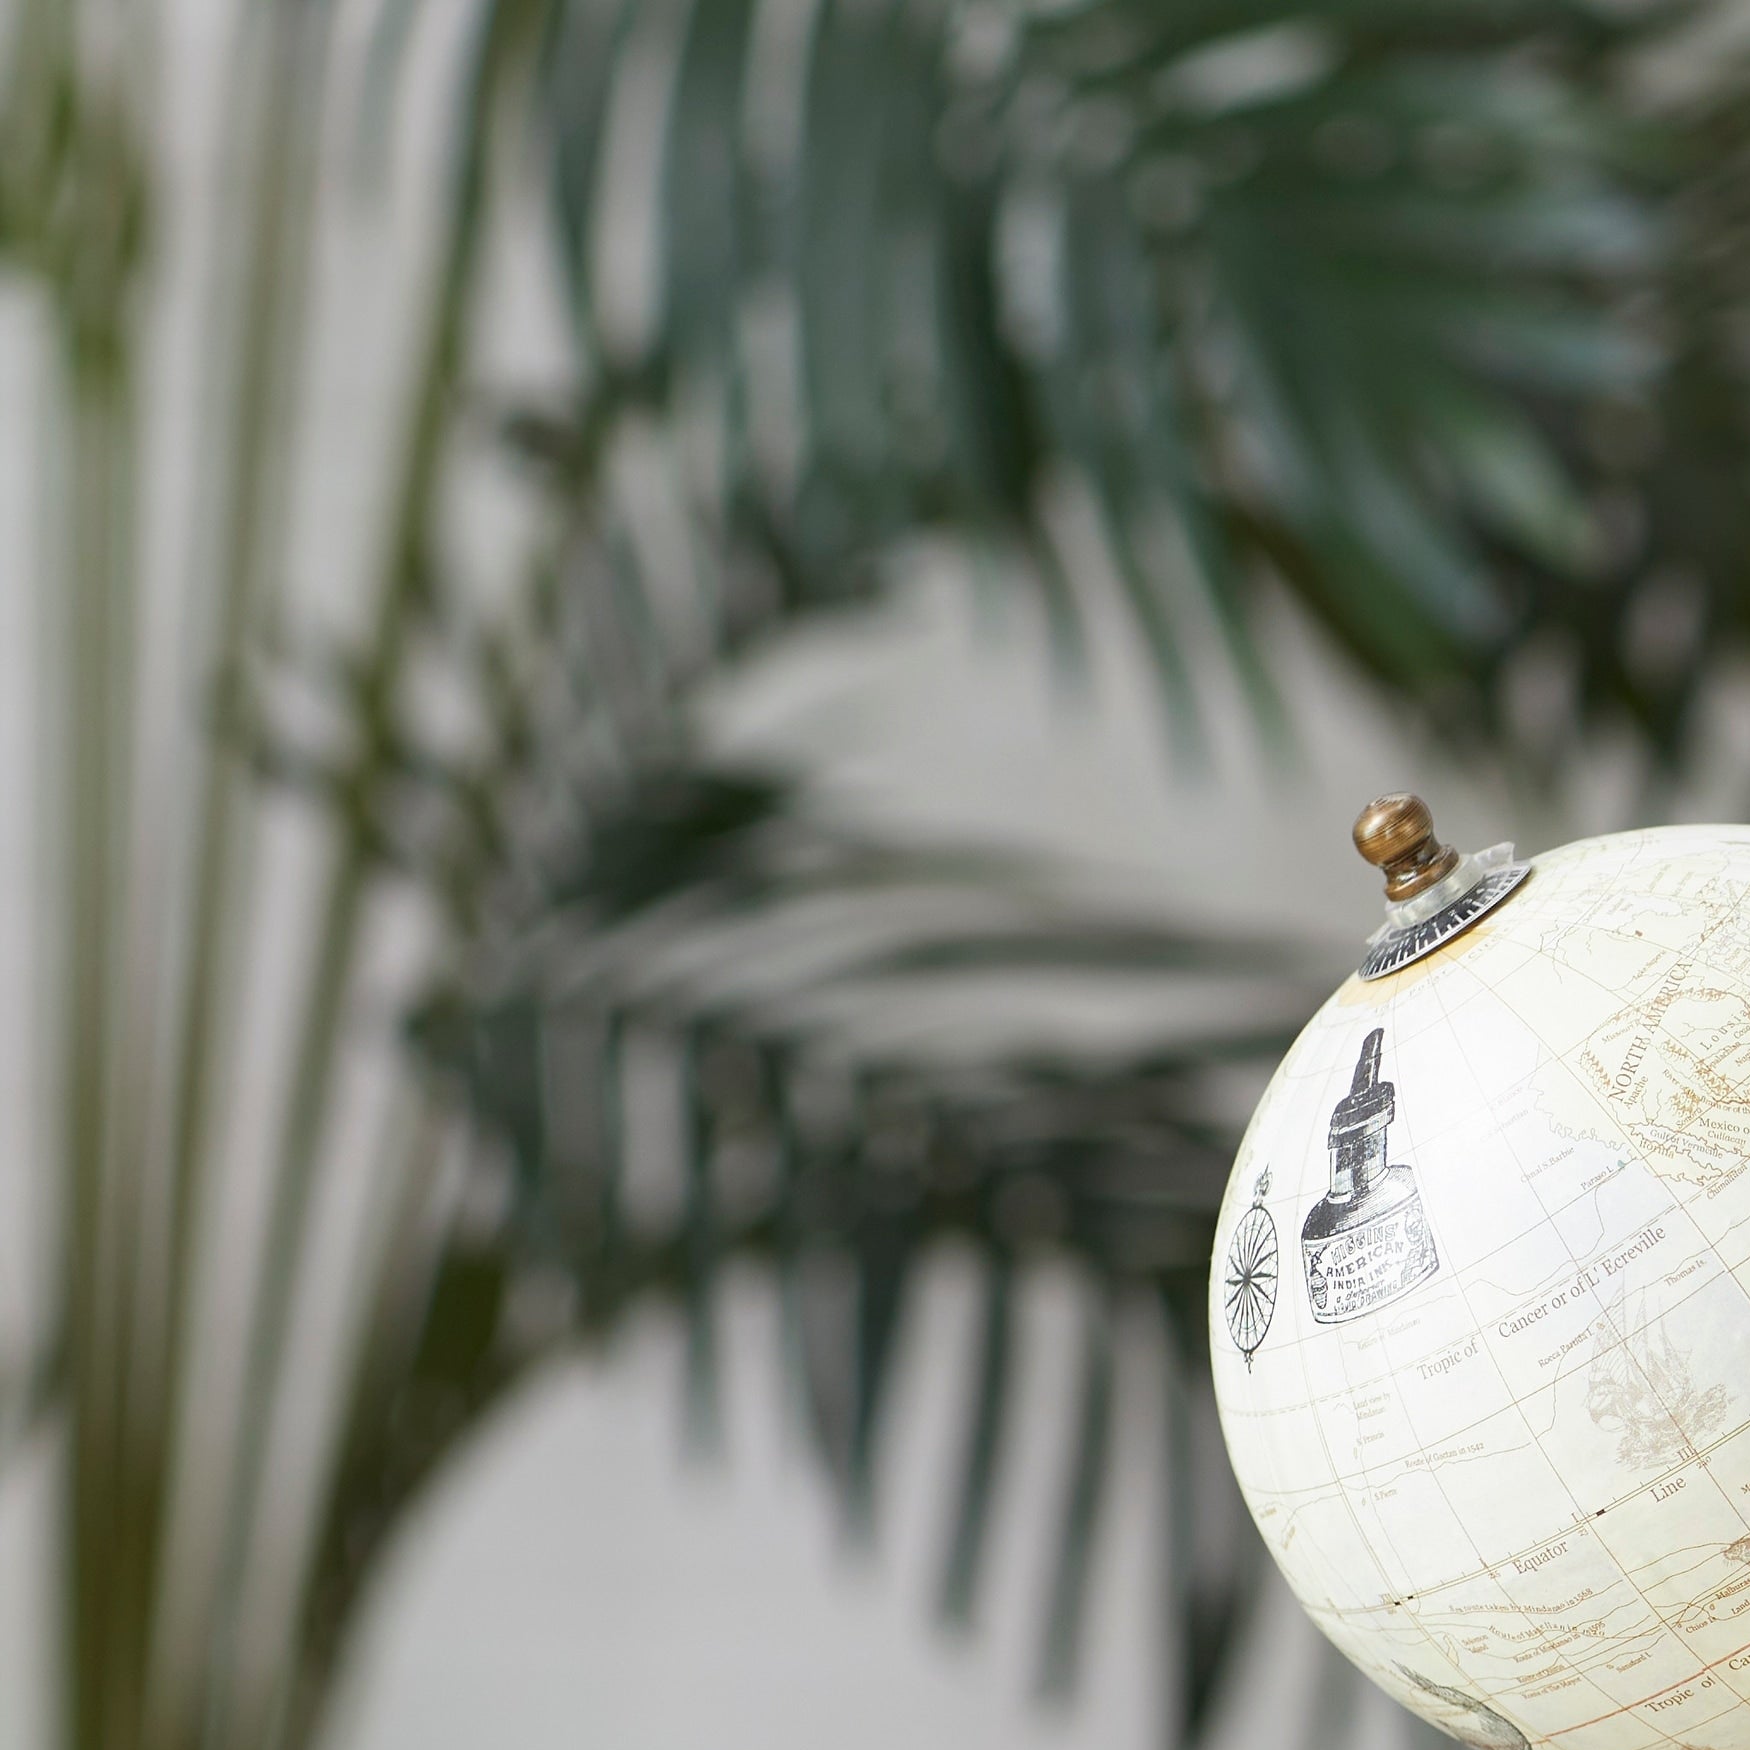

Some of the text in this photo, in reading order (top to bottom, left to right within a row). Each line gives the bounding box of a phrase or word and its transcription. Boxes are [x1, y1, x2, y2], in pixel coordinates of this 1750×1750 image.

[1608, 960, 1694, 1103] NORTH AMERICA
[1623, 1075, 1649, 1109] Apache
[1699, 1117, 1740, 1132] Mexico
[1326, 1241, 1404, 1278] AMERICAN
[1333, 1276, 1366, 1290] INDIA
[1416, 1350, 1463, 1381] Tropic
[1463, 1336, 1481, 1358] of
[1498, 1300, 1549, 1339] Cancer
[1551, 1292, 1568, 1310] or
[1570, 1276, 1587, 1299] of
[1600, 1224, 1667, 1278] Ecreville
[1650, 1477, 1687, 1504] Line
[1513, 1540, 1569, 1575] Equator
[1644, 1687, 1695, 1714] Tropic
